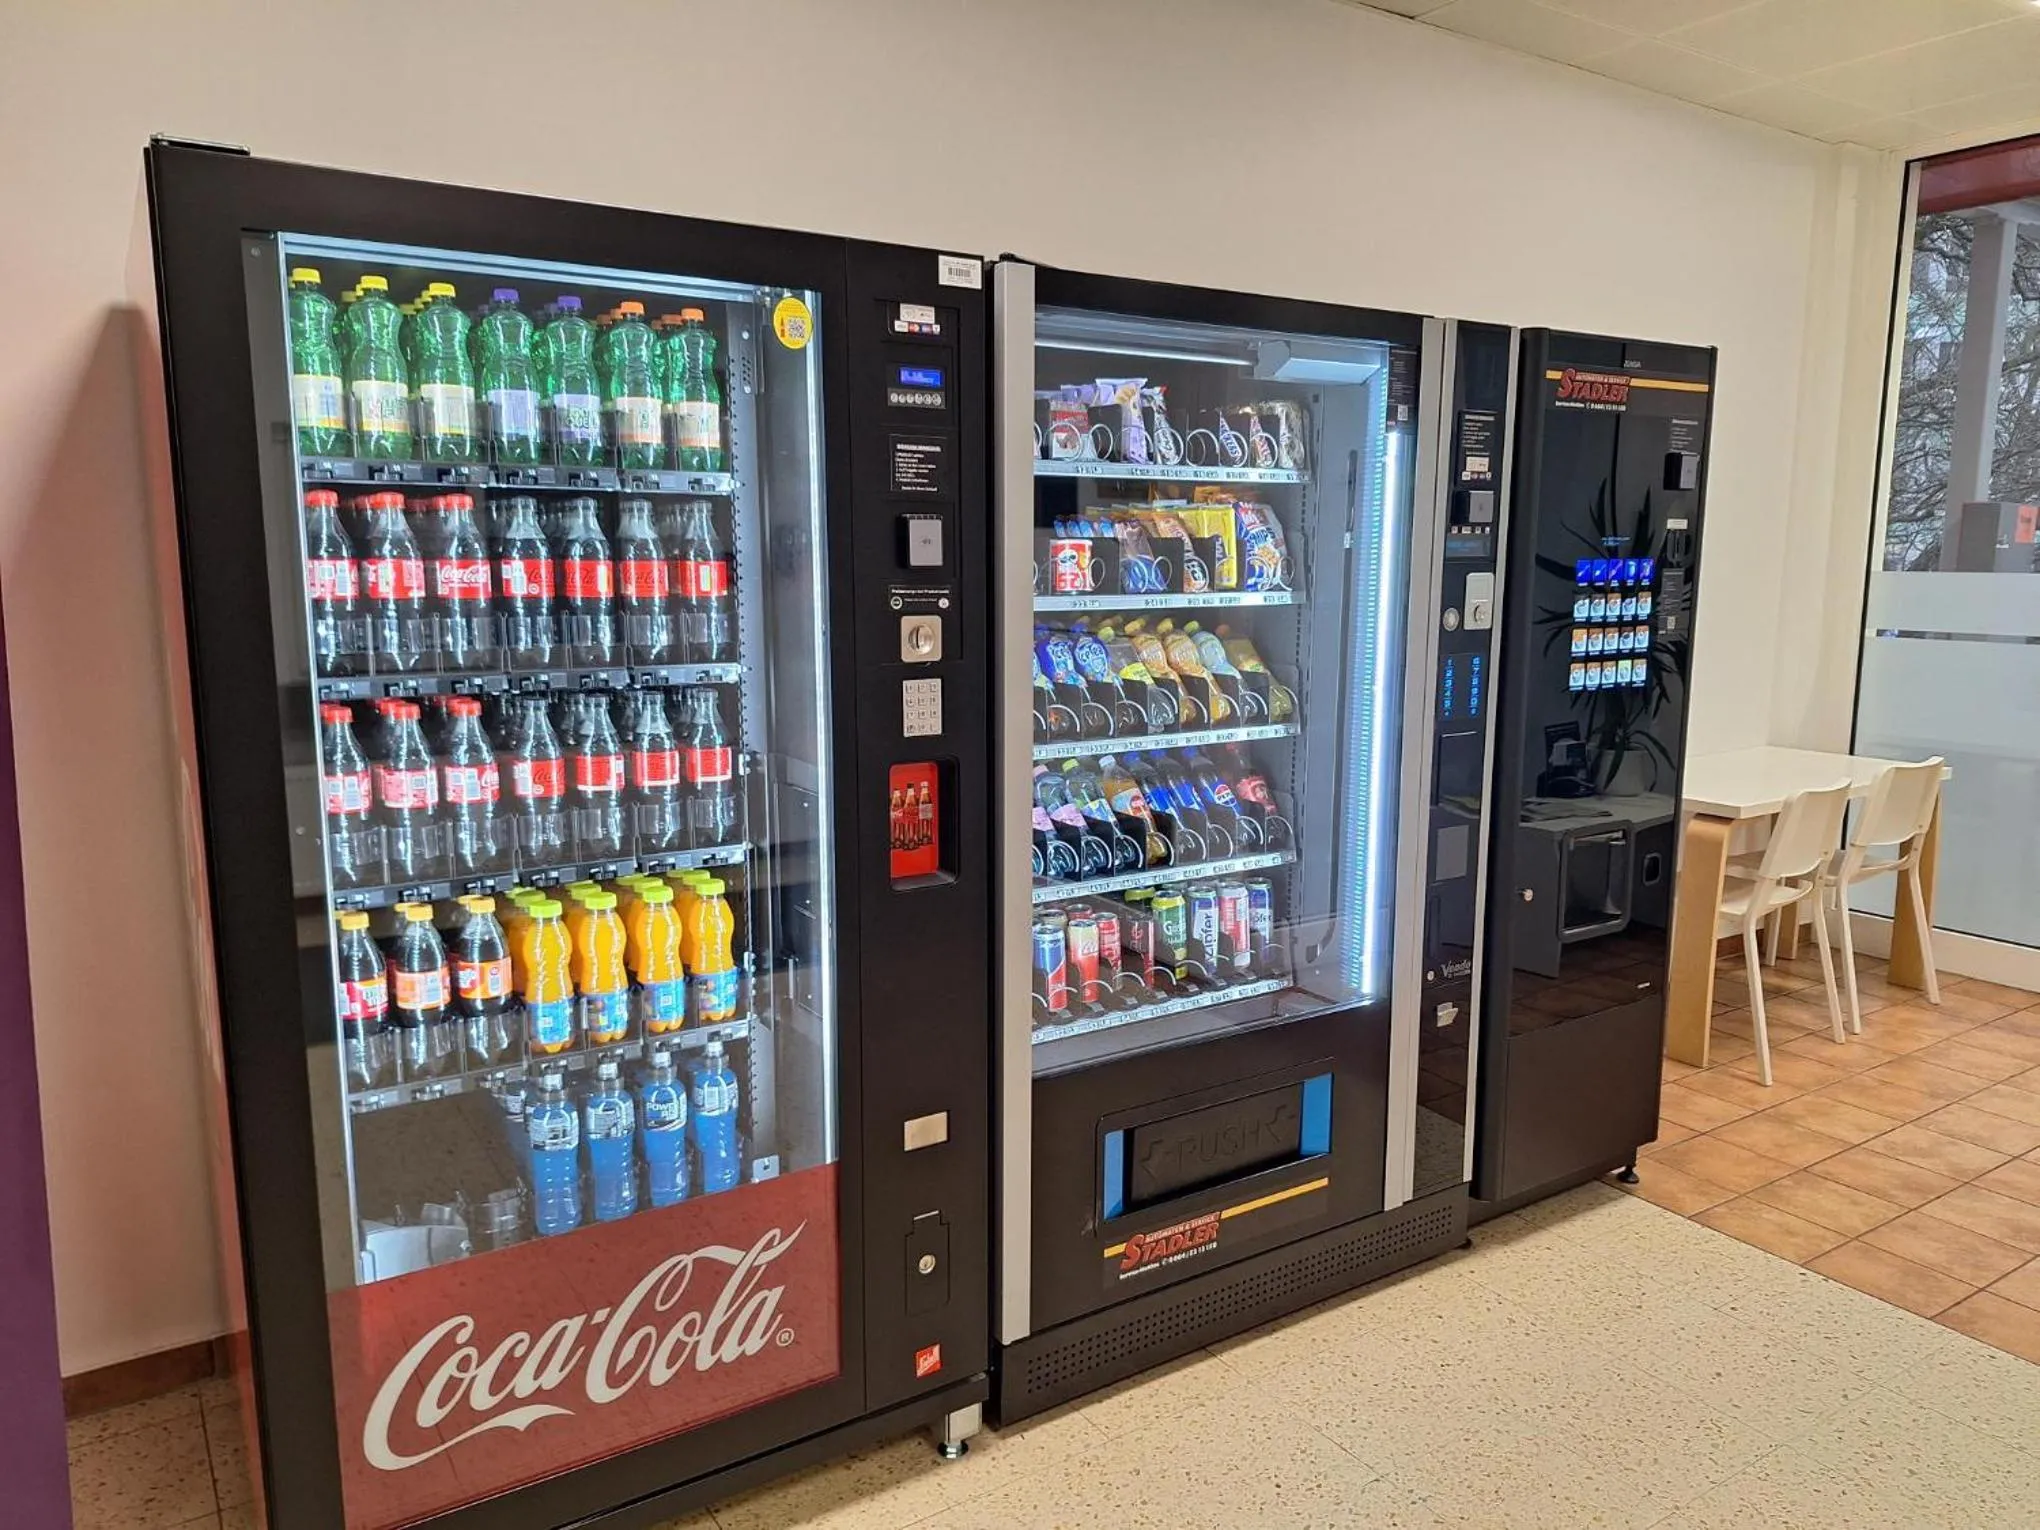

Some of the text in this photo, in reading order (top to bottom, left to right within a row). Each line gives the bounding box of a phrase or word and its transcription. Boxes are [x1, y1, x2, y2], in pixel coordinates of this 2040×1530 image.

[1556, 368, 1629, 403] STADLER
[1174, 1119, 1261, 1171] PUSH
[1120, 1222, 1219, 1271] STADLER
[362, 1219, 807, 1471] Coca-Cola
